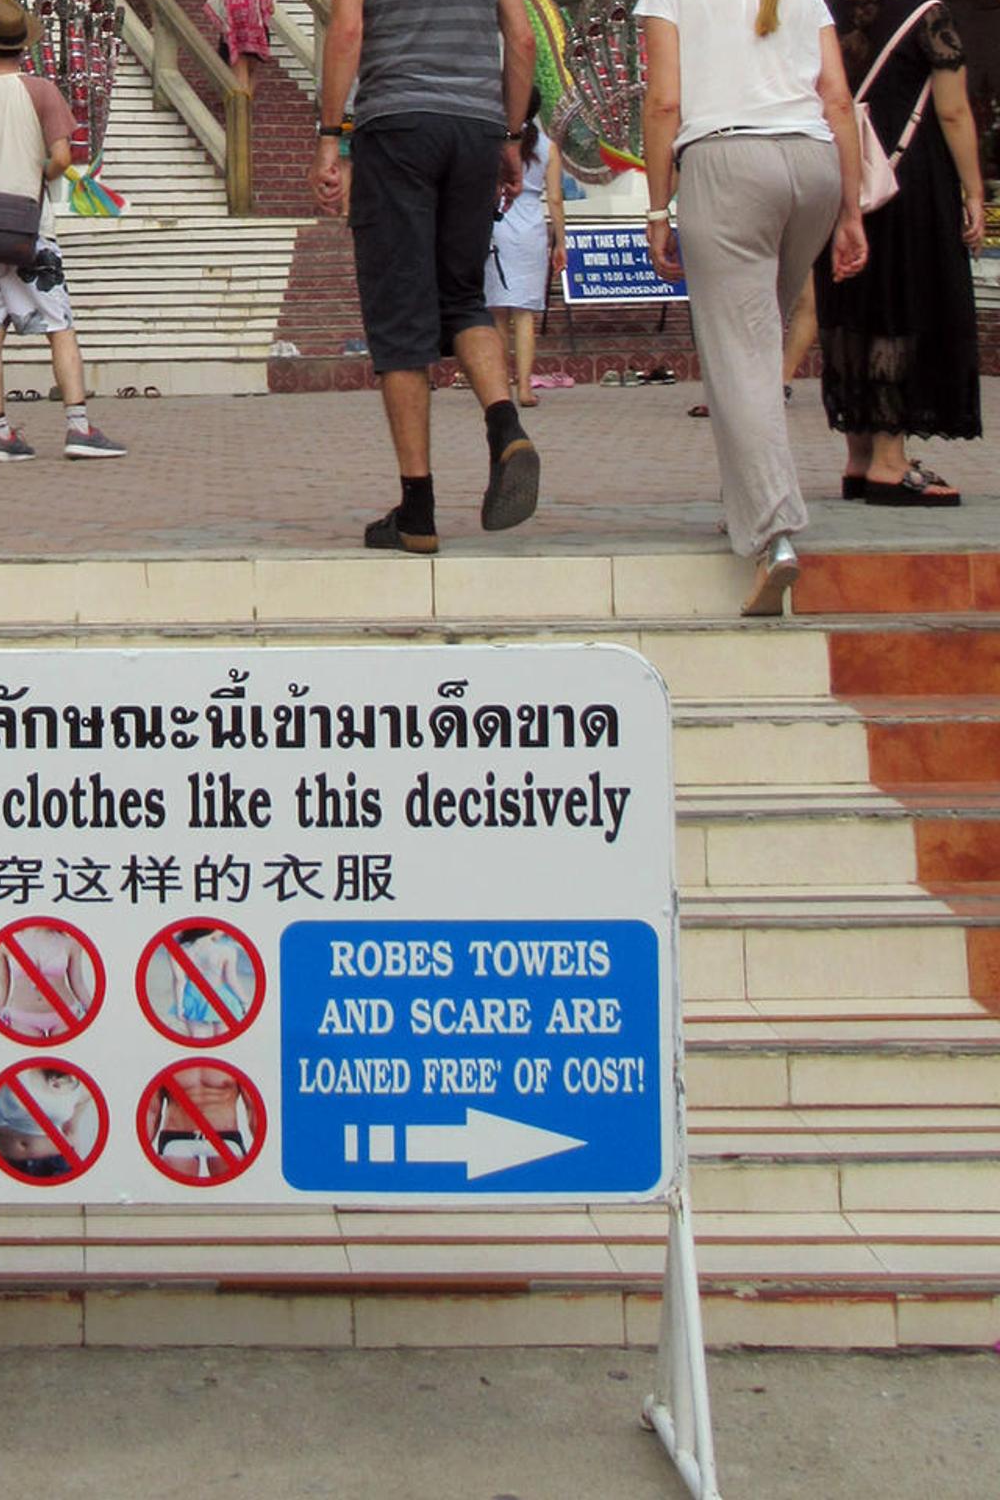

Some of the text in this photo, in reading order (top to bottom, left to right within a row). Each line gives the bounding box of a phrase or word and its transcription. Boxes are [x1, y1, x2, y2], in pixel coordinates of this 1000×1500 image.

[2, 771, 166, 829] clothes
[188, 771, 272, 829] like
[295, 771, 382, 829] this
[405, 770, 631, 843] decisively
[330, 941, 454, 977] ROBES
[318, 998, 622, 1034] AND SCARE ARE
[299, 1058, 411, 1094] LOANED
[513, 1058, 551, 1094] OF
[563, 1057, 645, 1094] COST!
